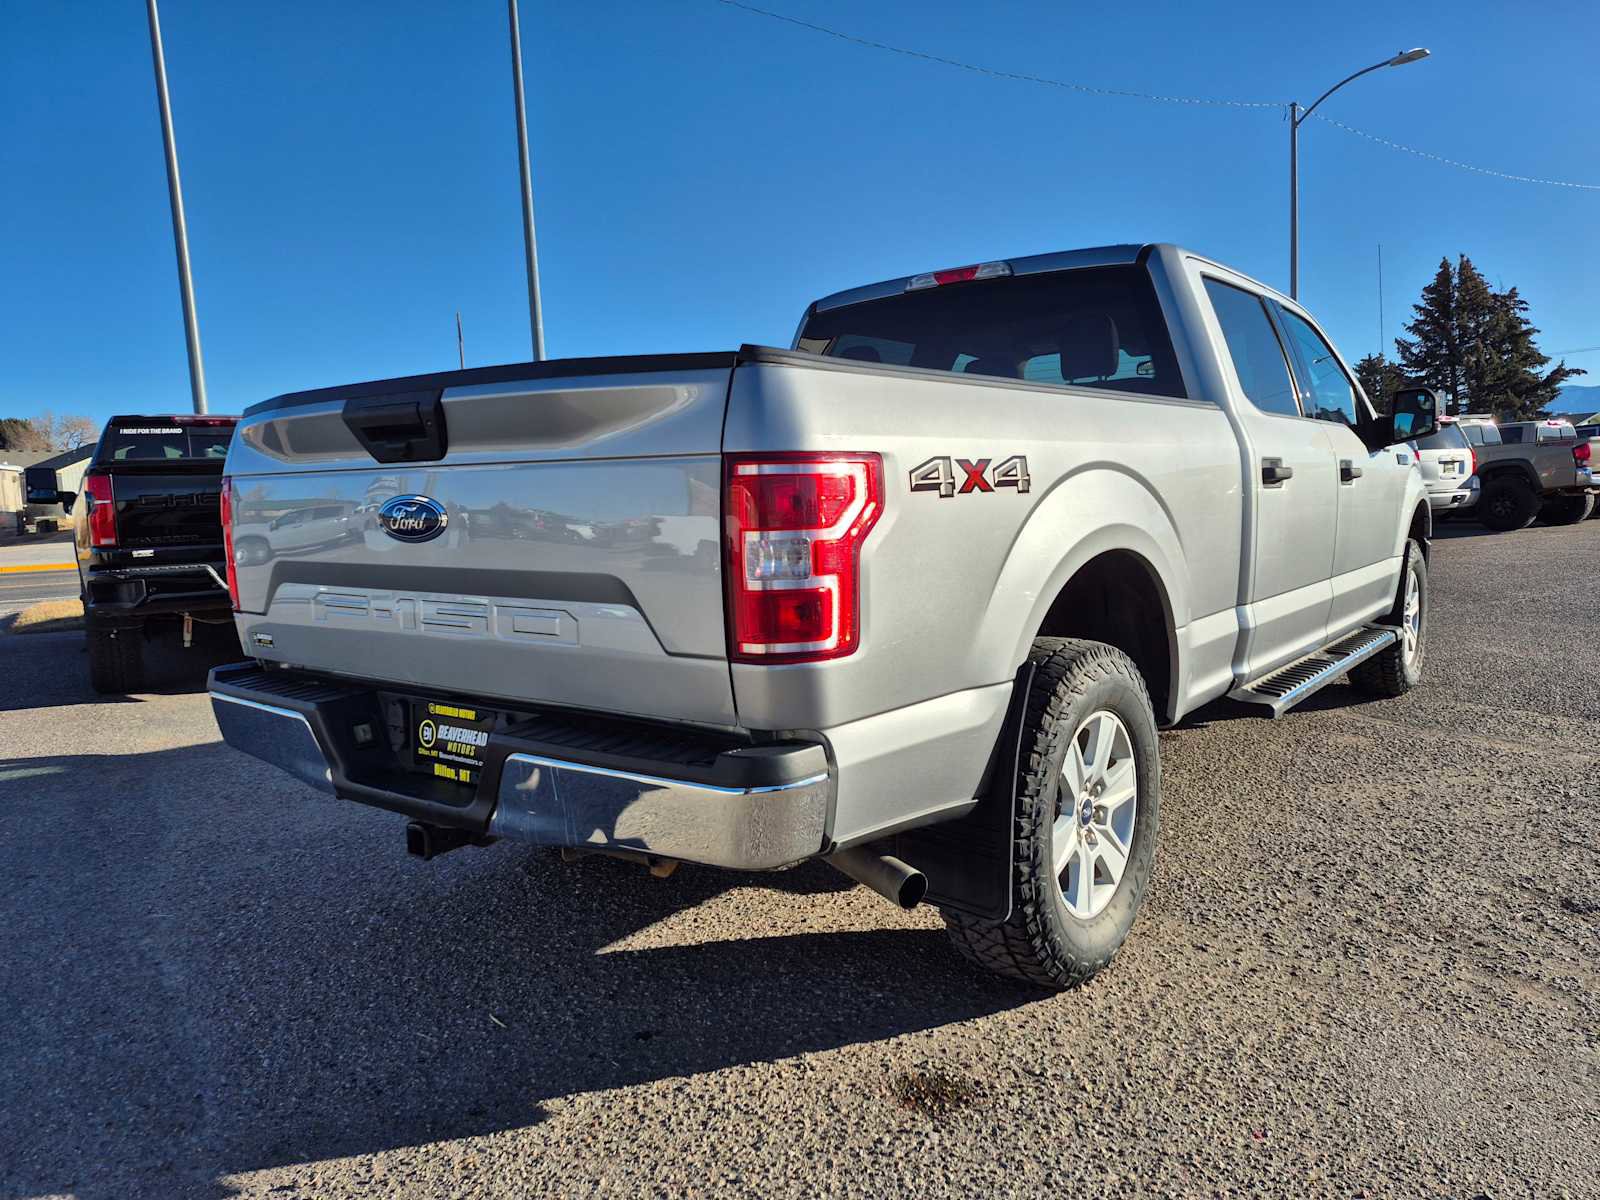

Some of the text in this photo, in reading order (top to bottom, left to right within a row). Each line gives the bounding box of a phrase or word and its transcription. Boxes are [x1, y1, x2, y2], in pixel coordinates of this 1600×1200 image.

[390, 503, 426, 530] Ford
[311, 592, 580, 647] F-150
[438, 724, 488, 747] BEAVERHEAD
[447, 742, 476, 756] MOTORS
